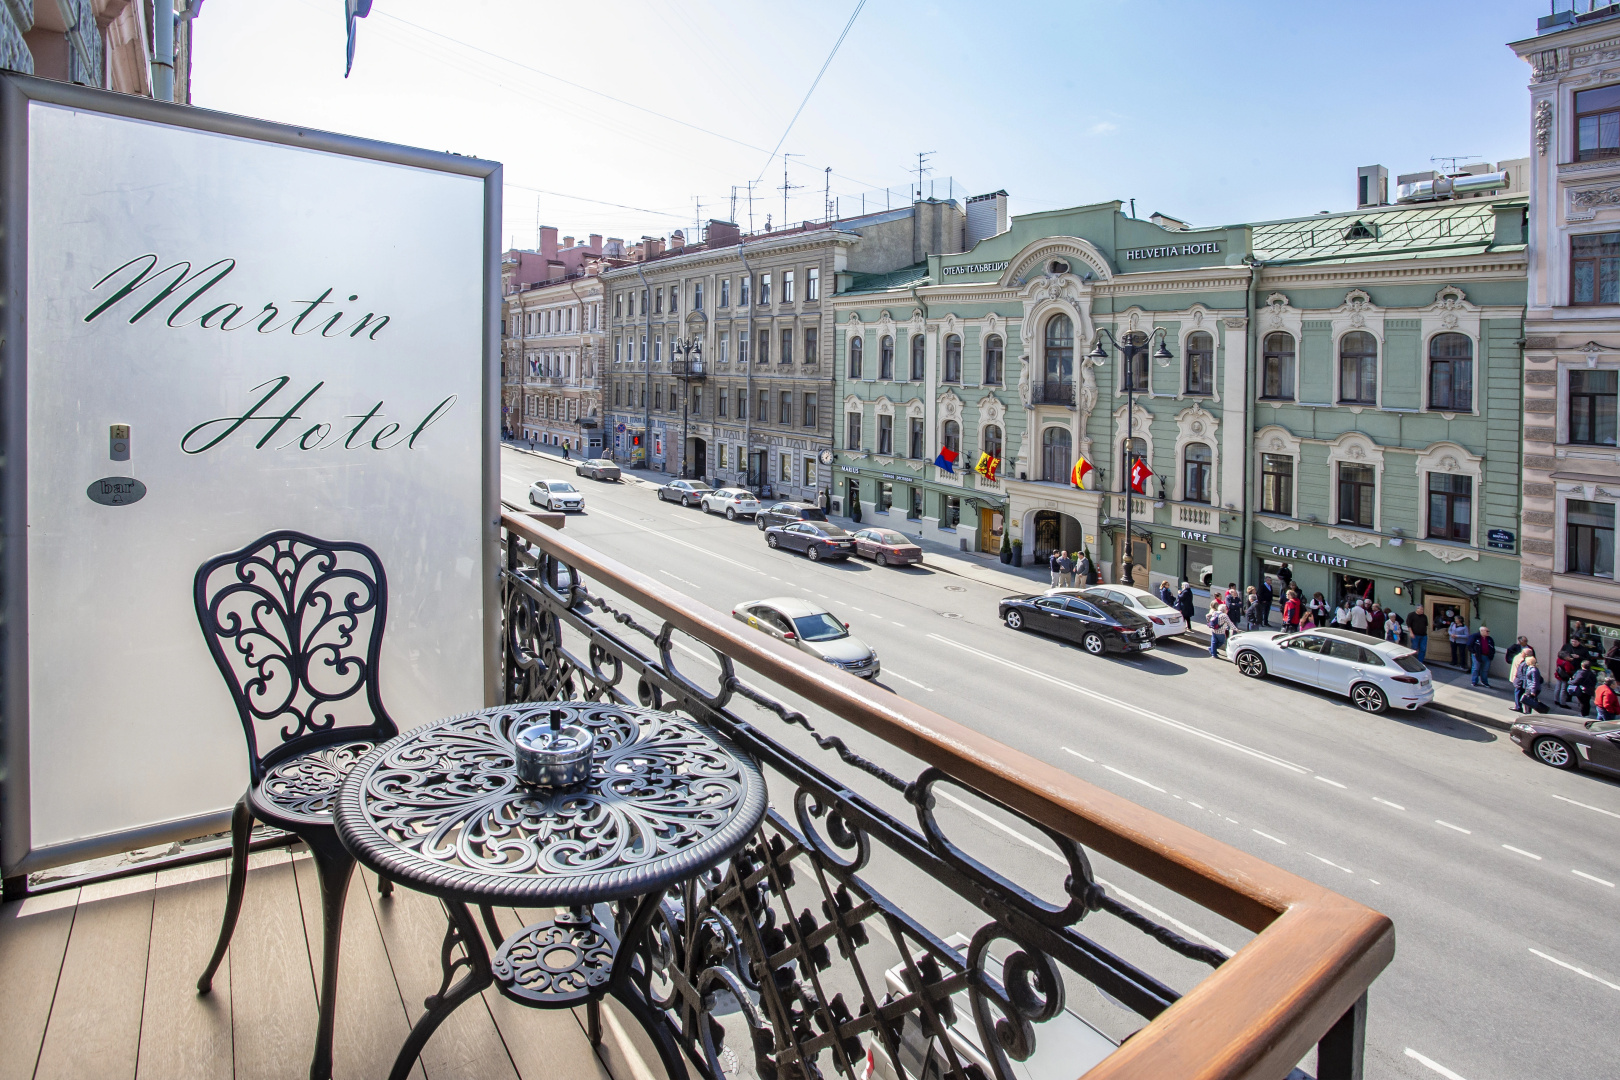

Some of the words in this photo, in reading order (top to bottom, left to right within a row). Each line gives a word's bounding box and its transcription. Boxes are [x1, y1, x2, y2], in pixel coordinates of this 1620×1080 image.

[1126, 246, 1178, 260] HELVETIA
[1182, 242, 1220, 255] HOTEL
[943, 266, 965, 275] ОТЕЛЬ
[967, 261, 1009, 273] ГЕЛЬВЕЦИЯ
[84, 254, 390, 340] Martin
[181, 376, 458, 454] Hotel
[101, 480, 135, 494] bar
[1272, 546, 1298, 559] CAFE
[1307, 552, 1349, 568] CLARET
